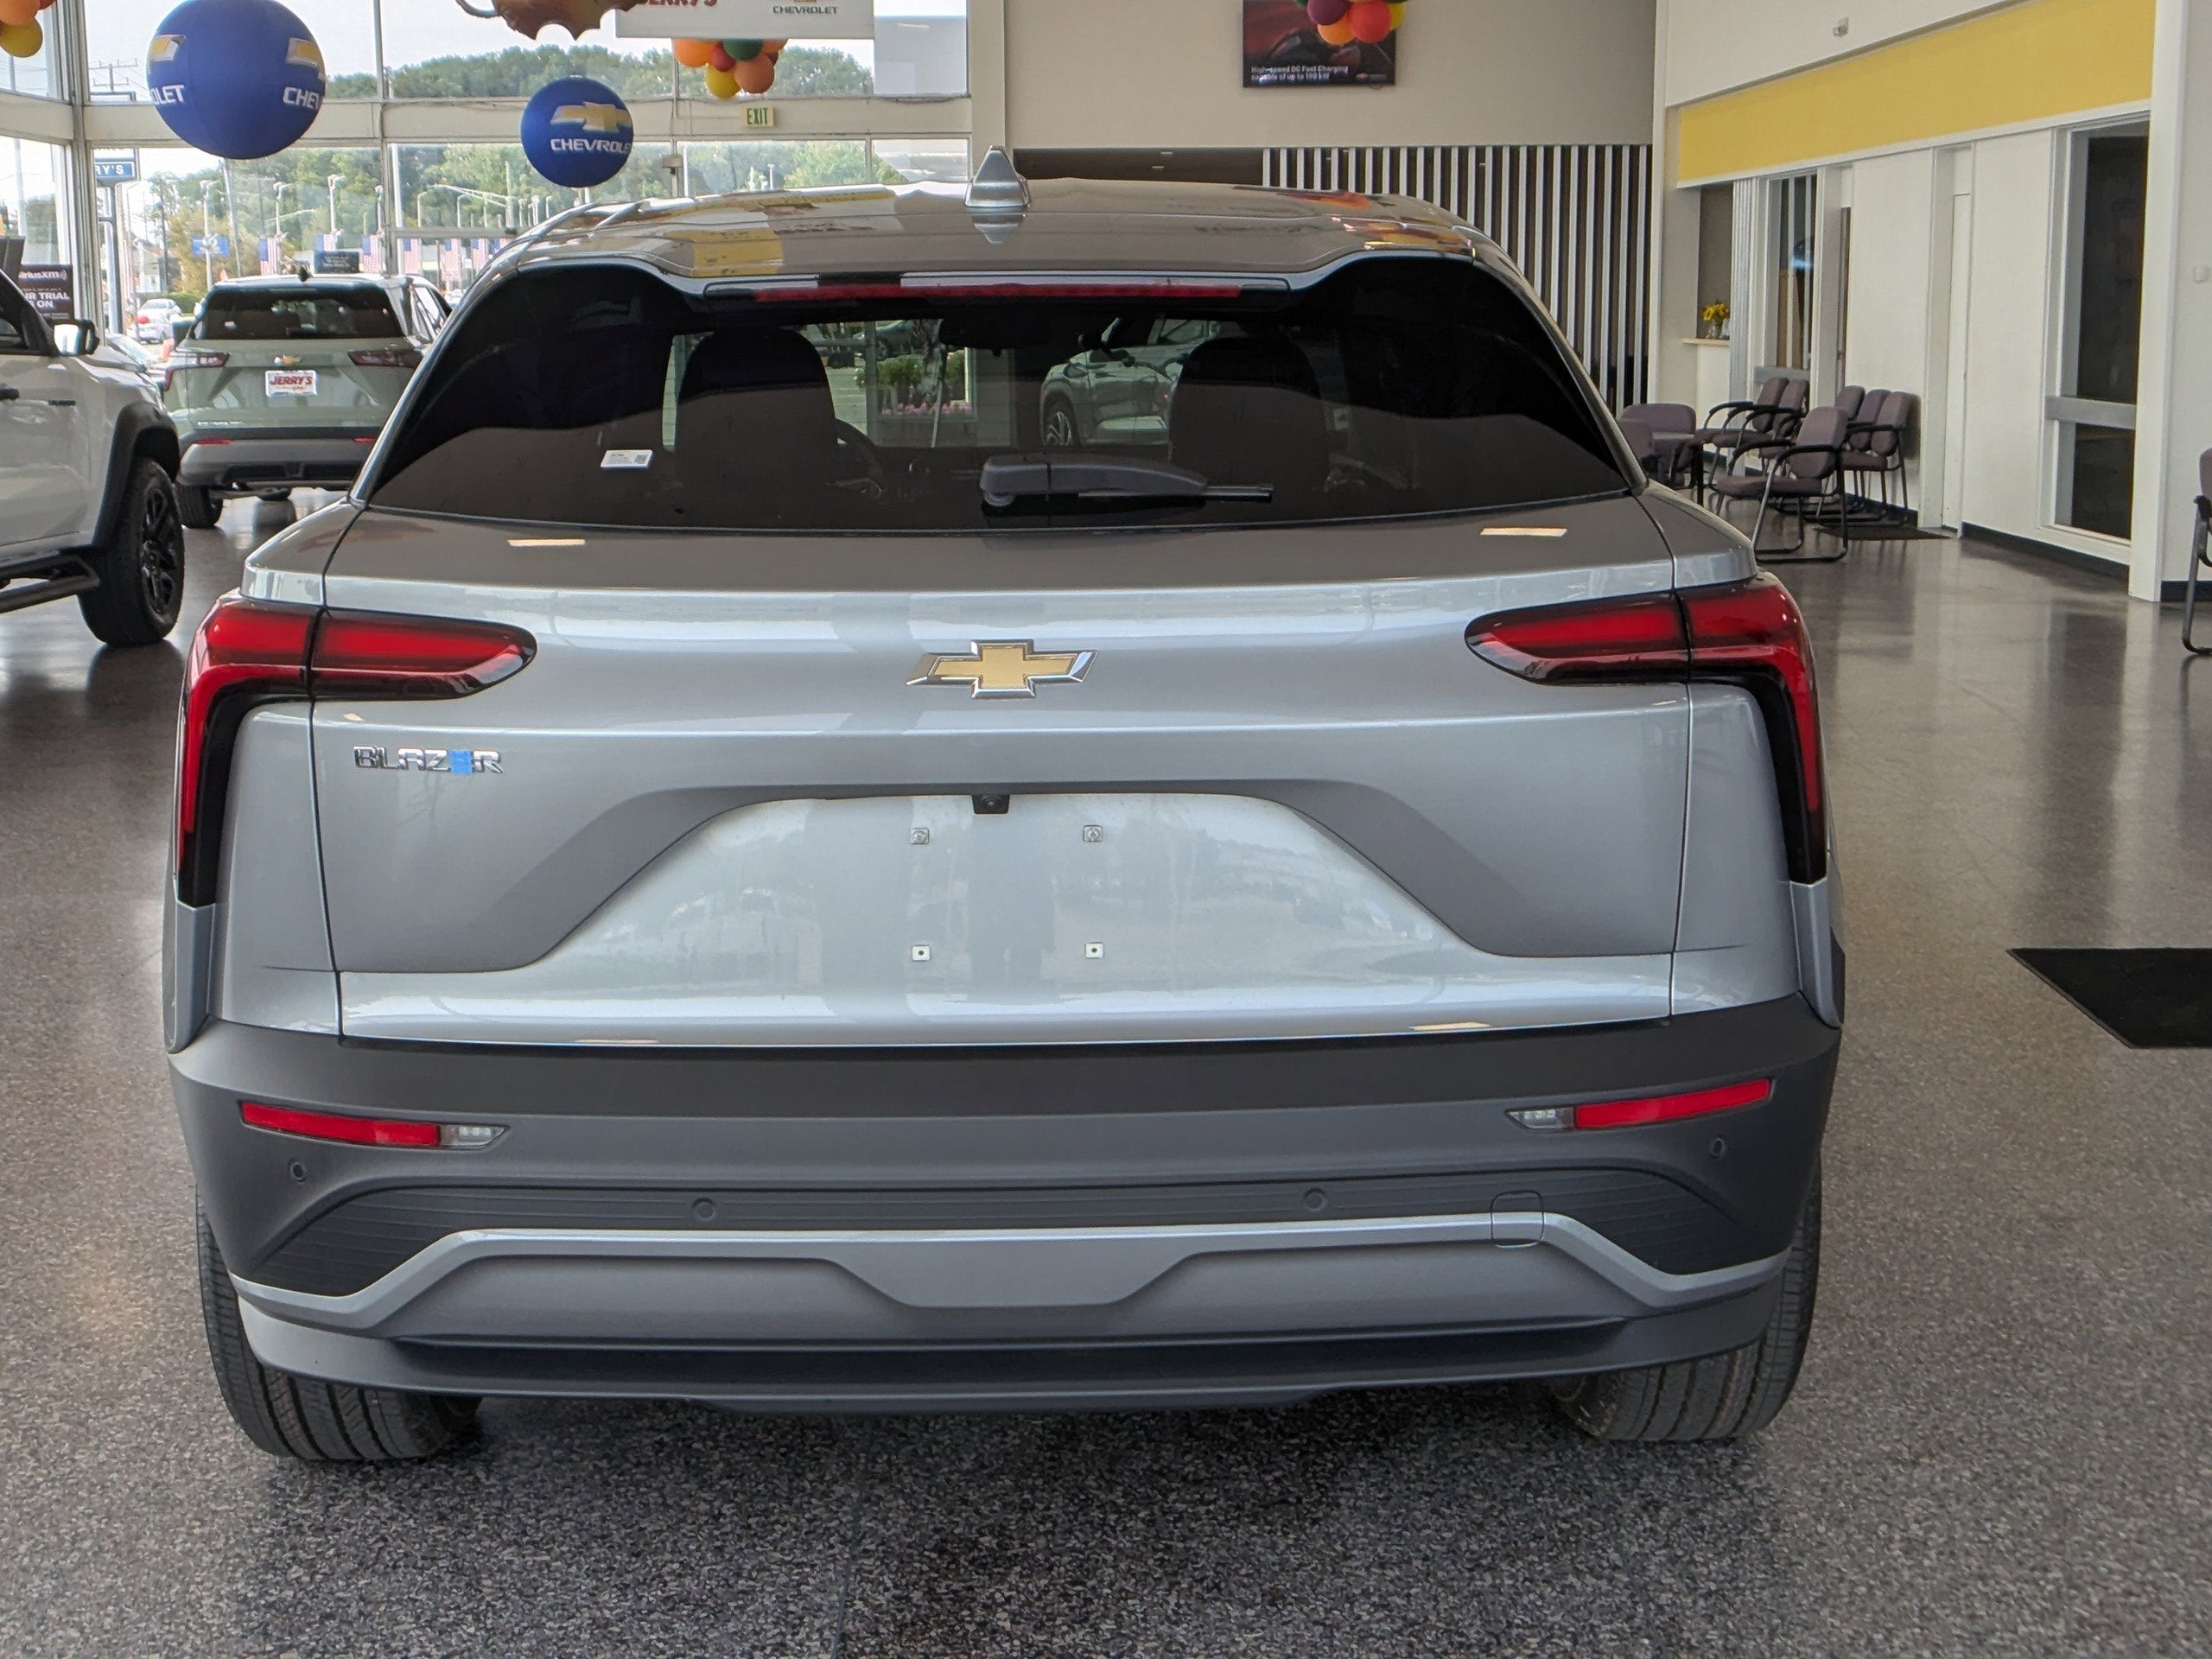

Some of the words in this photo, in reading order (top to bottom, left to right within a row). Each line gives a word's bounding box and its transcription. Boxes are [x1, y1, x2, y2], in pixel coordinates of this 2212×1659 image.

[772, 5, 838, 15] CHEVROLET
[747, 107, 768, 125] EXIT
[270, 376, 313, 385] JERRY'S
[353, 745, 504, 774] BLAZER
